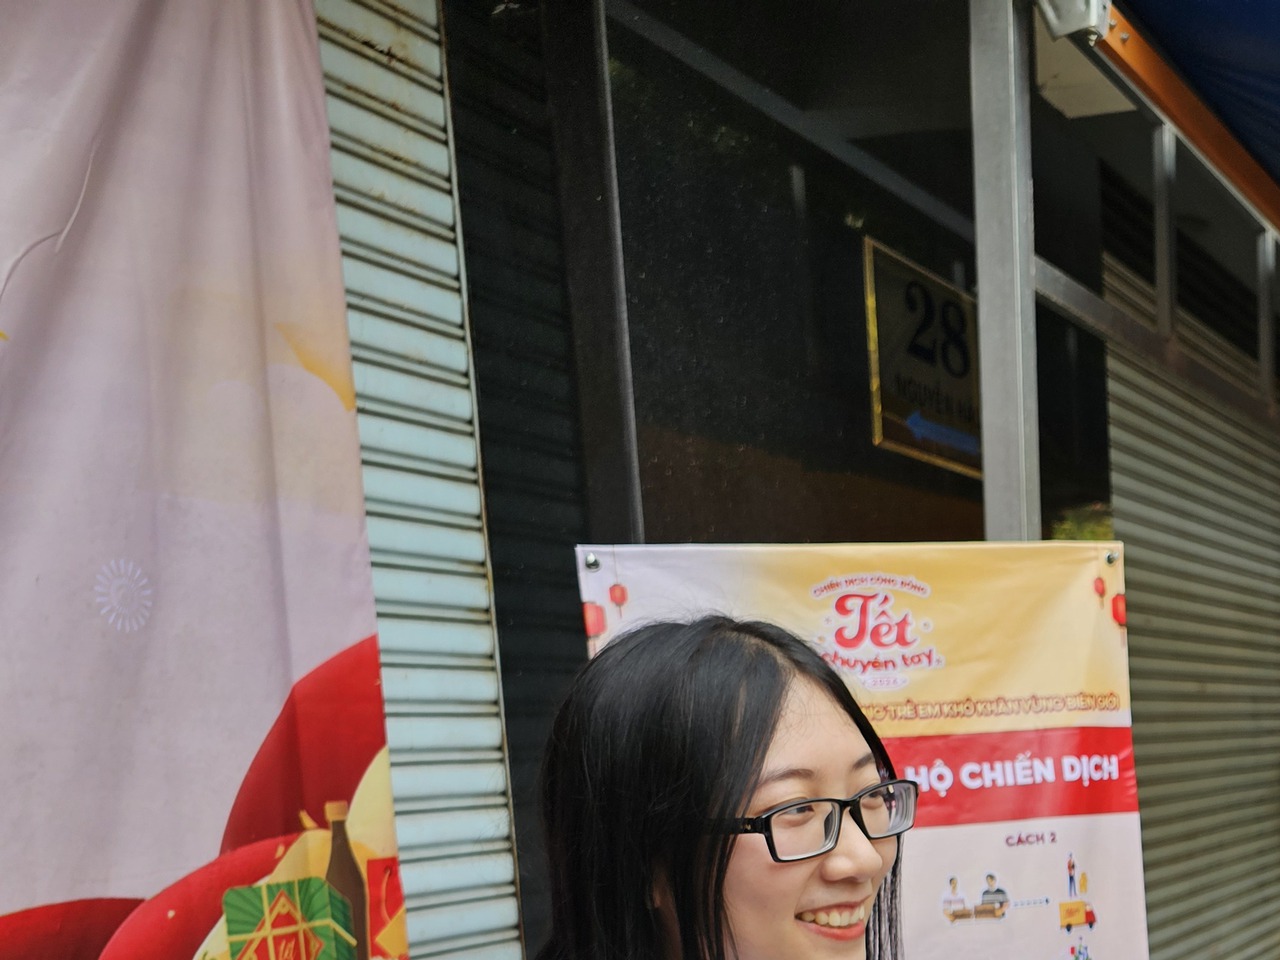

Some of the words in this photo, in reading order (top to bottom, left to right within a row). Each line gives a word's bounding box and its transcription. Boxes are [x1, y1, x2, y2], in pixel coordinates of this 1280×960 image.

[905, 280, 971, 379] 28
[834, 593, 917, 648] Tết
[902, 648, 936, 667] tay
[886, 698, 916, 719] TRẺ
[919, 702, 941, 718] EM
[942, 697, 976, 718] KHÓ
[977, 697, 1022, 717] KHĂN
[1023, 695, 1066, 714] VÙNG
[1066, 692, 1096, 712] BIÊN
[1096, 692, 1120, 711] GIỚI
[904, 758, 954, 798] HỘ
[960, 751, 1056, 790] CHIẾN
[1062, 754, 1120, 788] DỊCH
[1006, 832, 1045, 848] CÁCH
[1050, 832, 1057, 844] 2
